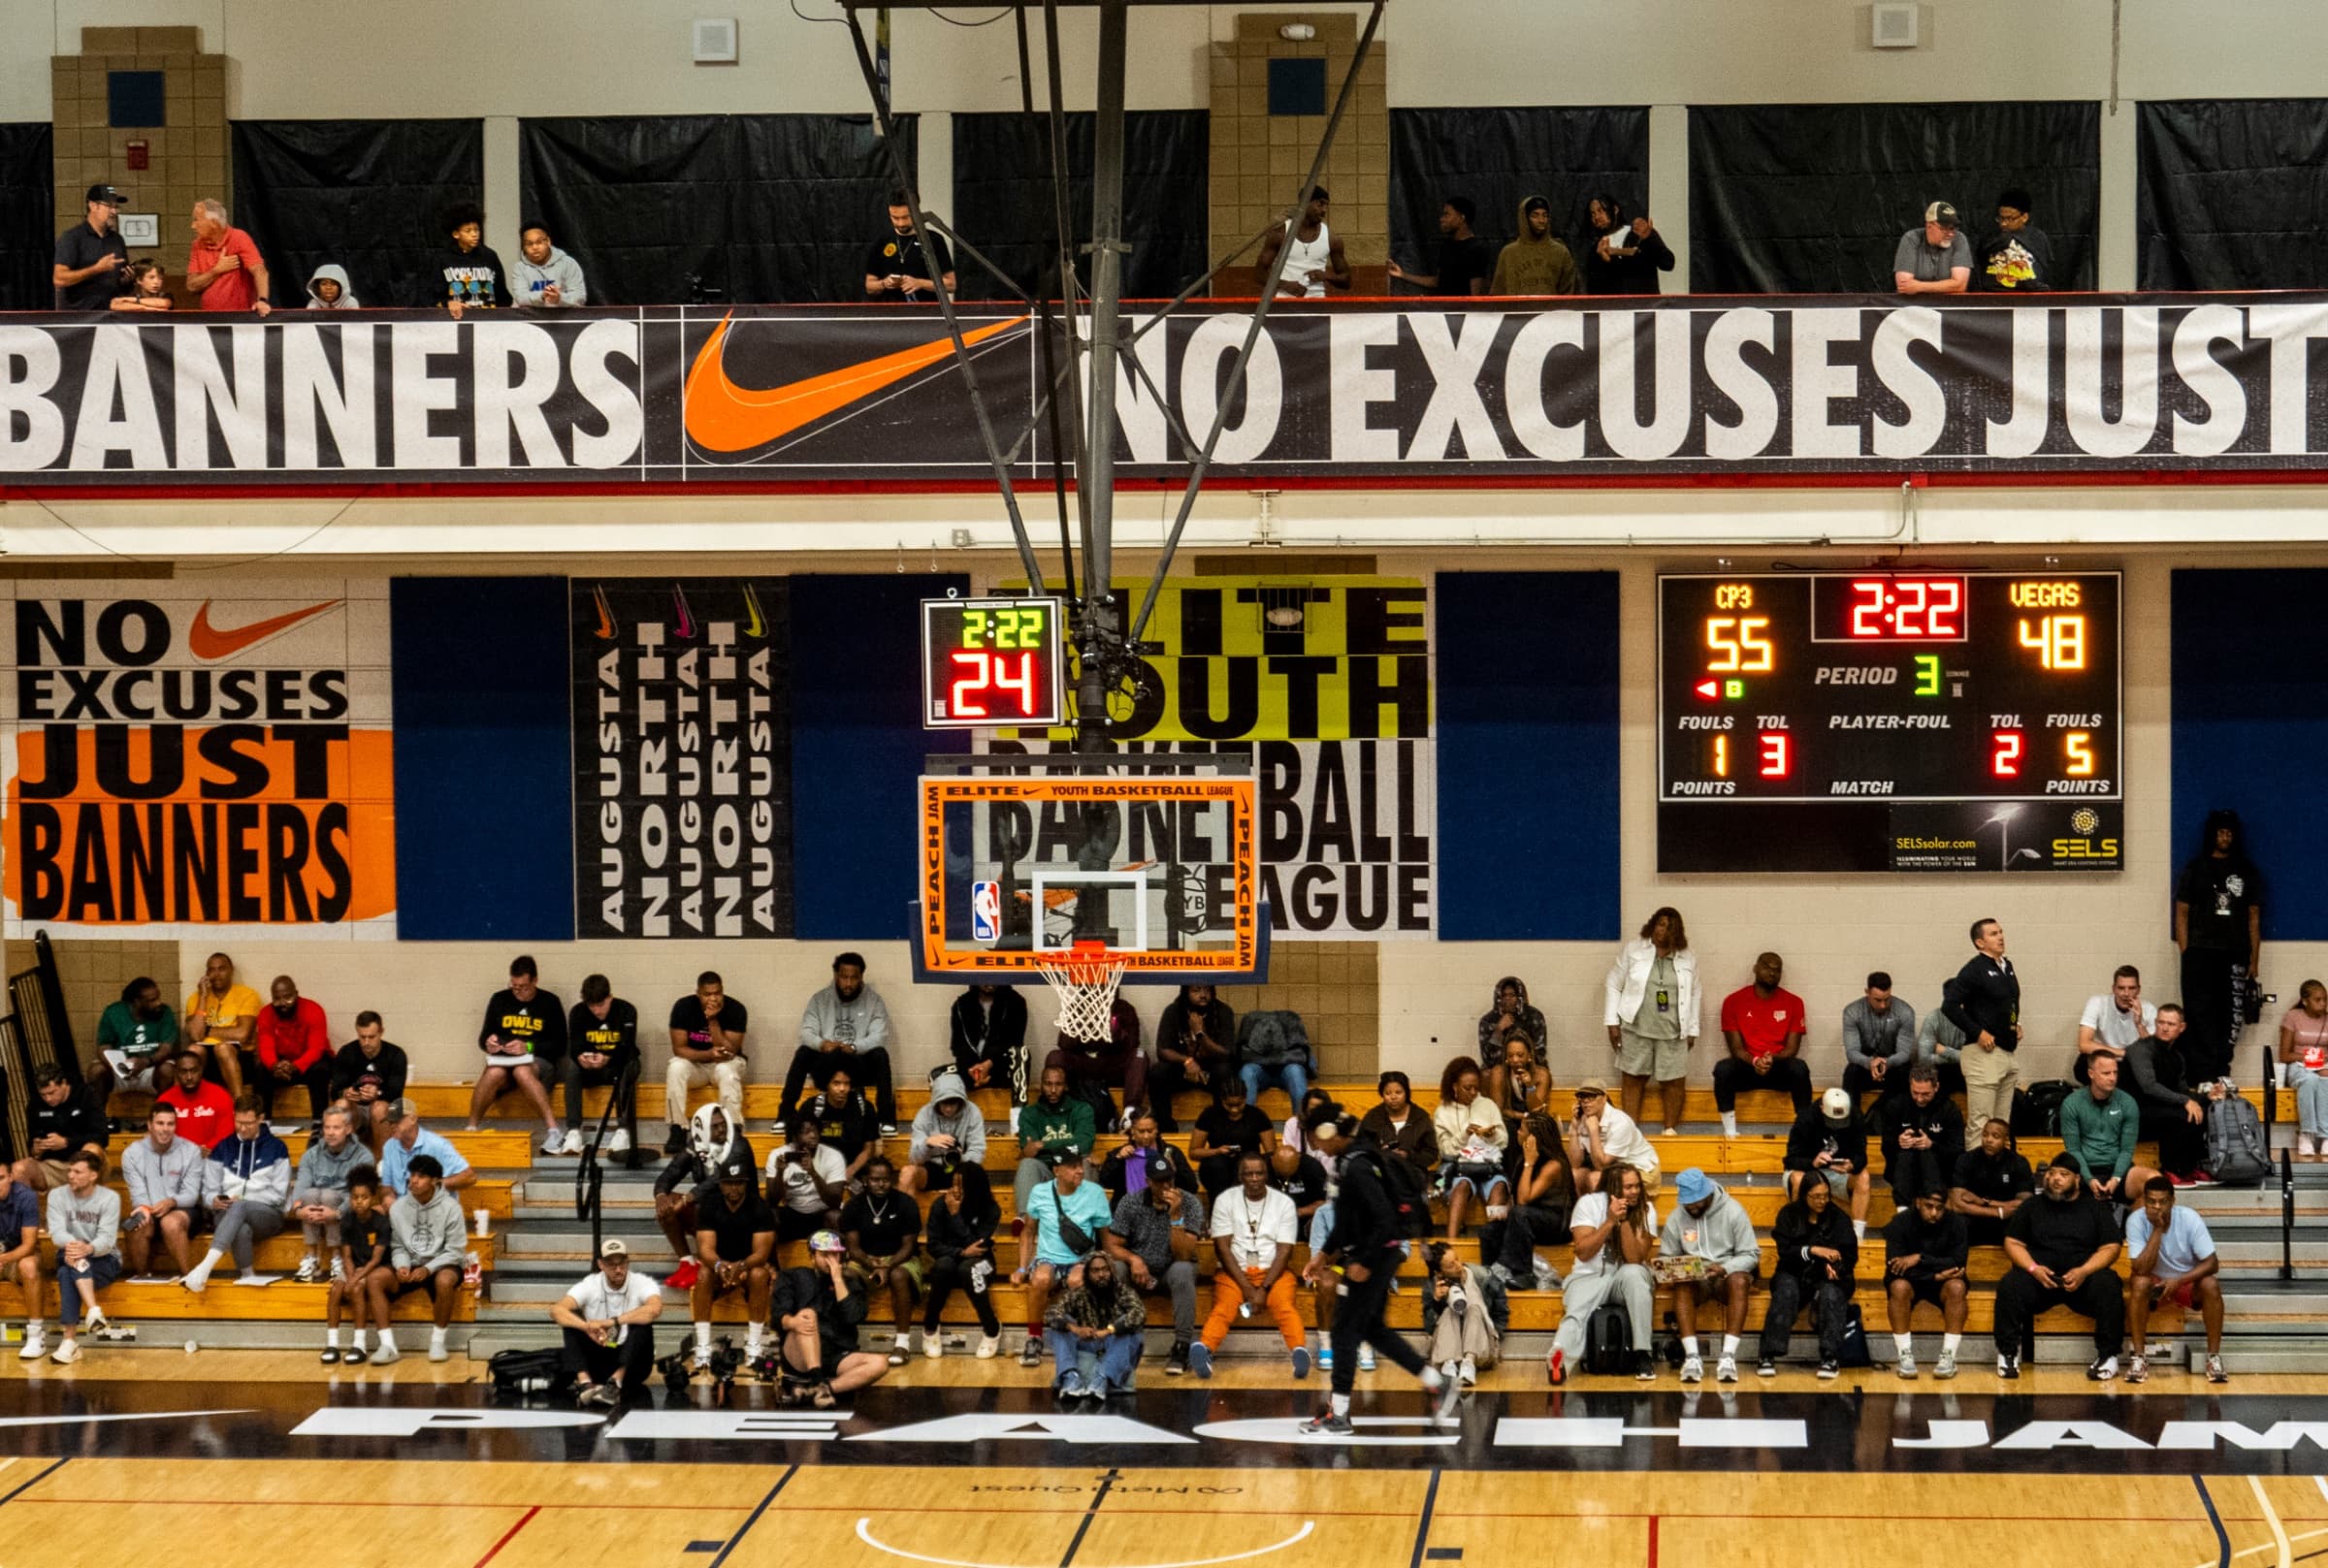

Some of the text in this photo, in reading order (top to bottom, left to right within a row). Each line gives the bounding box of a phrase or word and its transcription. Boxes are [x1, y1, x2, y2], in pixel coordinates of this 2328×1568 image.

[0, 318, 643, 470] BANNERS
[1074, 304, 2328, 464] NO EXCUSES JUST
[1715, 584, 1753, 609] CP3
[1853, 583, 1959, 635] 2:22
[2011, 584, 2080, 607] VEGAS
[16, 599, 171, 667] NO
[962, 611, 1043, 649] 2:22
[987, 588, 1428, 656] LITE
[2020, 615, 2086, 669] 48
[1706, 618, 1774, 671] 55
[17, 669, 349, 720] EXCUSES
[952, 653, 1033, 716] 24
[1814, 656, 1939, 695] PERIOD 3
[999, 656, 1428, 740] OUTH
[1678, 715, 1734, 729] FOULS
[1757, 715, 1789, 729] TOL
[1828, 715, 1952, 729] PLAYER-FOUL
[1990, 714, 2023, 728] TOL
[2046, 714, 2102, 727] FOULS
[18, 723, 349, 800] JUST
[1714, 734, 1726, 777] 1
[1760, 735, 1787, 776] 3
[1993, 734, 2020, 775] 2
[2065, 732, 2093, 775] 5
[598, 647, 625, 933] AUGUSTA
[636, 622, 670, 938] NORTH
[677, 647, 703, 933] AUGUSTA
[708, 622, 743, 938] NORTH
[748, 647, 775, 933] AUGUSTA
[946, 785, 1234, 796] ELITE YOUTH BASKETBALL LEAGUE
[987, 740, 1429, 863] BAKEBALL
[1671, 781, 1736, 795] POINTS
[1830, 781, 1894, 794] MATCH
[2045, 780, 2110, 793] POINTS
[19, 802, 352, 923] BANNERS
[928, 785, 940, 935] PEACH JAM
[1896, 836, 1977, 849] SELSsolar.com
[2053, 839, 2118, 857] SELS
[1179, 864, 1429, 932] EAGUE
[1239, 818, 1251, 967] PEACH JAM
[1138, 956, 1215, 966] BASKETBALL
[501, 1014, 543, 1031] OWLS
[586, 1031, 621, 1043] OWLS
[288, 1407, 2328, 1450] PEACH JAM
